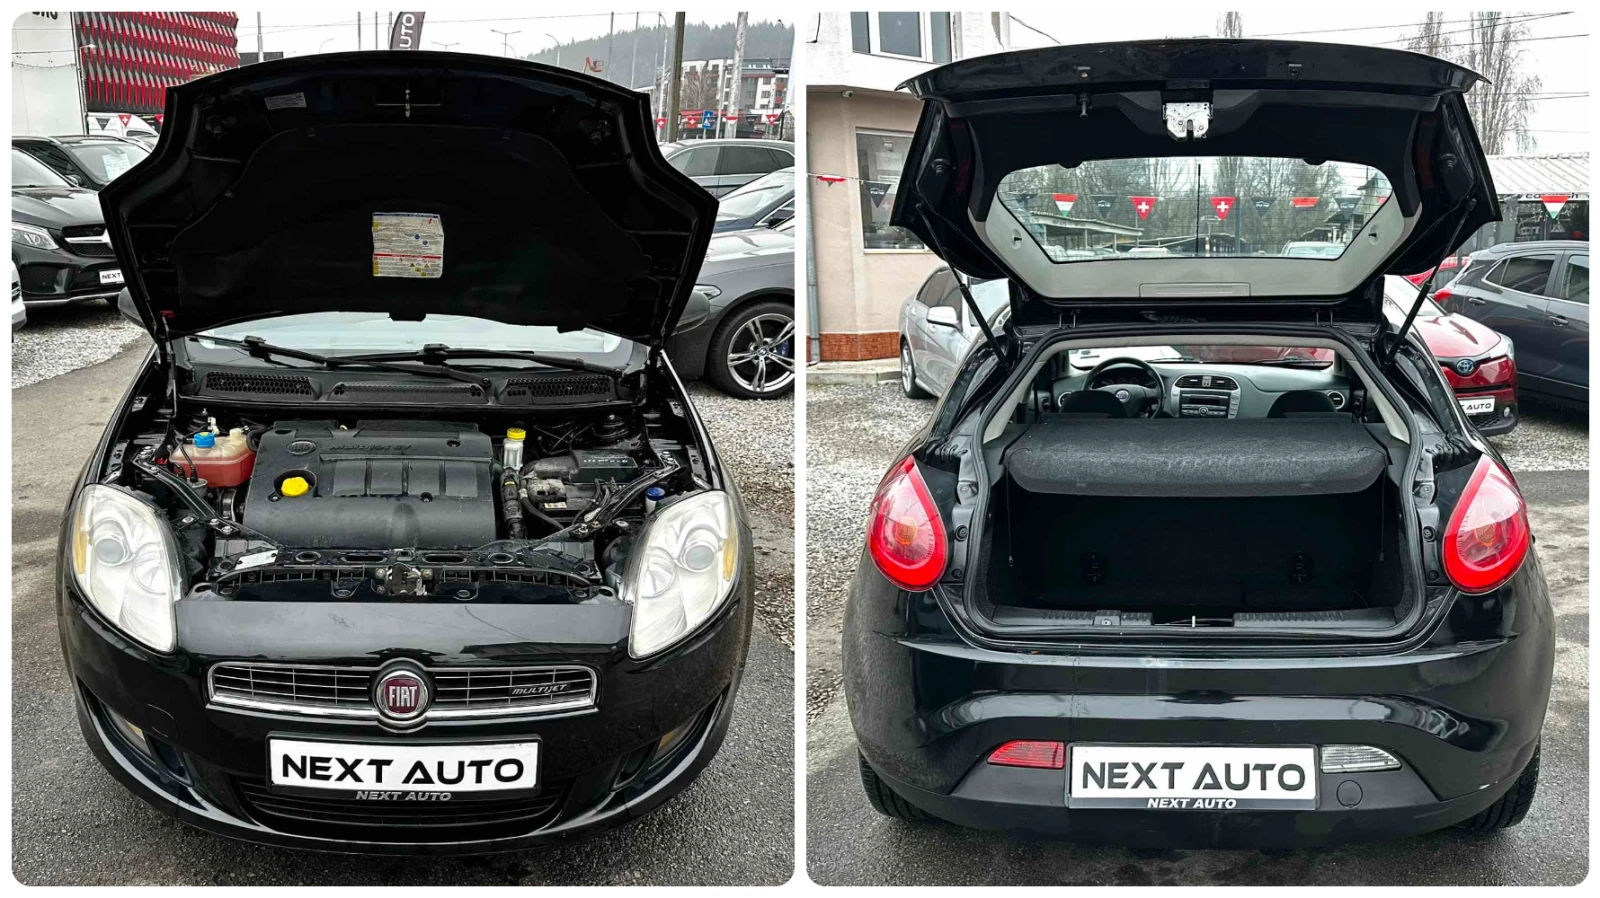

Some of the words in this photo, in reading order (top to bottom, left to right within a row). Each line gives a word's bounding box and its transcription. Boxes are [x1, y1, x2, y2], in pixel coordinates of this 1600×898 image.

[400, 13, 415, 50] UTO
[1466, 403, 1492, 411] AUTO
[388, 685, 418, 707] FIAT
[511, 683, 568, 695] MULTIJET
[282, 753, 394, 784] NEXT
[401, 758, 524, 785] AUTO
[1082, 761, 1185, 790] NEXT
[1192, 762, 1306, 792] AUTO
[356, 790, 402, 800] NEXT
[405, 791, 452, 801] AUTO
[1147, 798, 1190, 809] NEXT
[1192, 798, 1237, 809] AUTO
